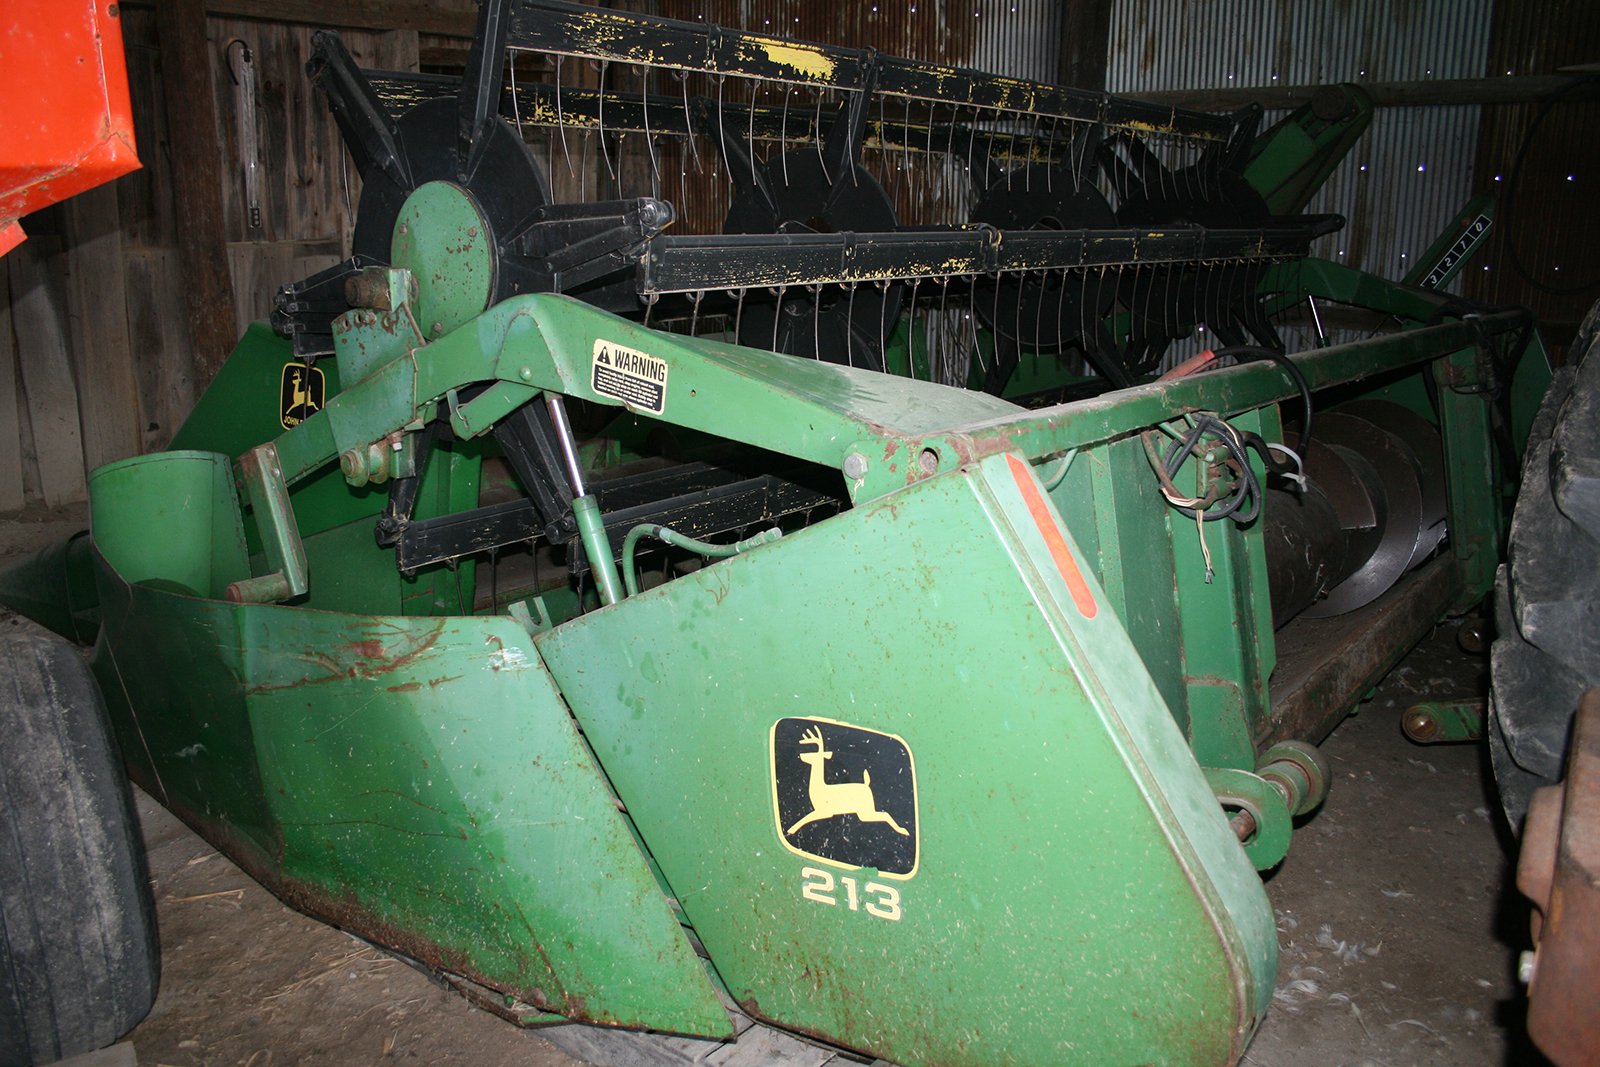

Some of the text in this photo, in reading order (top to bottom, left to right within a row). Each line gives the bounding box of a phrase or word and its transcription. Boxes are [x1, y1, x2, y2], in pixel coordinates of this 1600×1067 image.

[614, 349, 666, 382] WARNING
[283, 415, 299, 425] JOHN
[801, 866, 901, 921] 213
